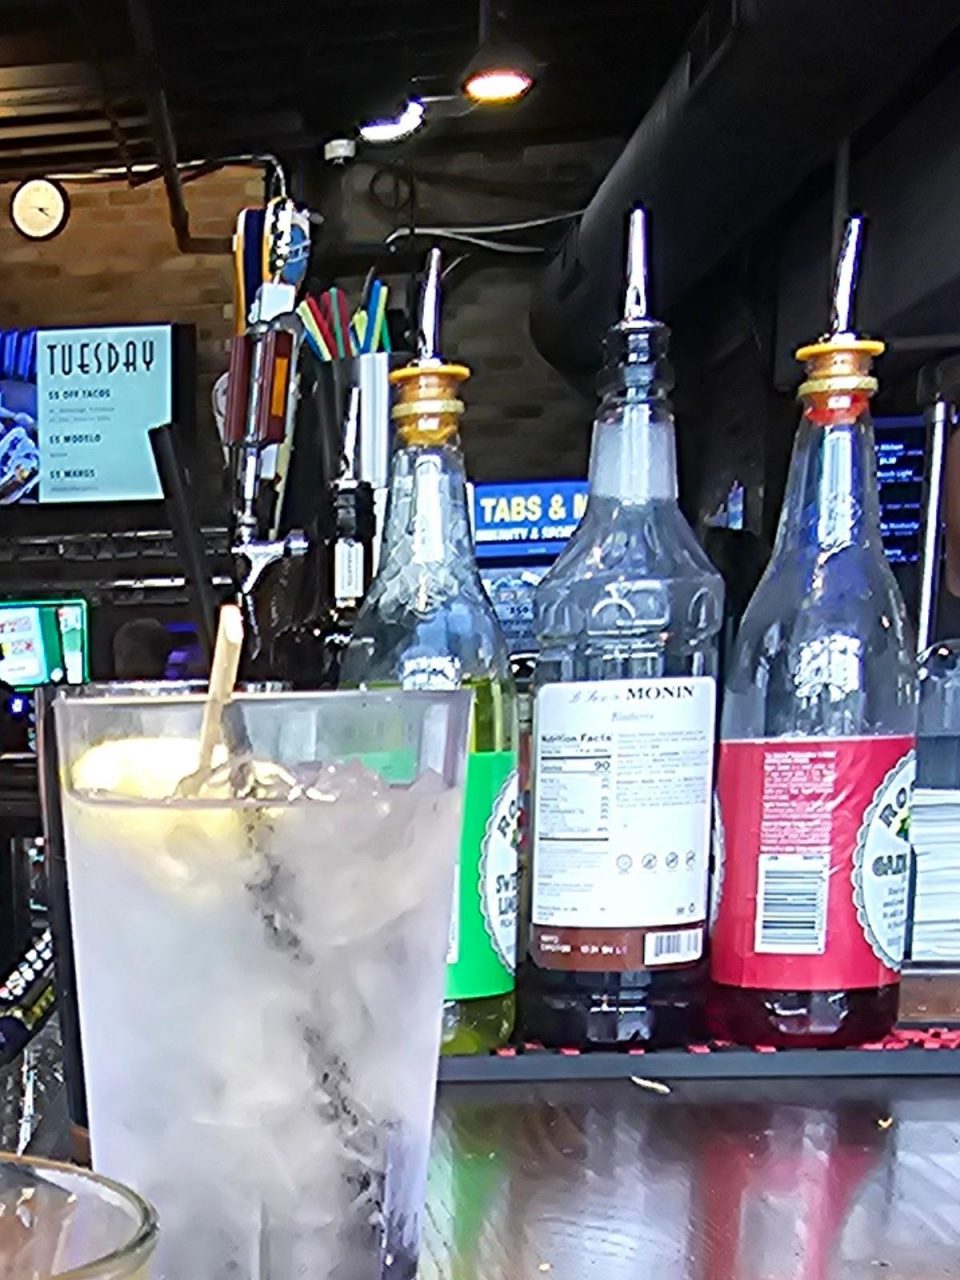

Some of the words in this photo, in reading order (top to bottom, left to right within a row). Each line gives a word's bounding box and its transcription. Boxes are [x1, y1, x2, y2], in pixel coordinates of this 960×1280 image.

[46, 340, 155, 376] TUESDAY
[63, 390, 79, 399] OFF
[82, 388, 111, 399] TACOS
[63, 433, 102, 444] MODELO
[63, 469, 95, 479] MARGS
[479, 494, 542, 524] TABS
[548, 493, 566, 521] &
[626, 685, 696, 701] MONIN
[580, 732, 612, 743] Facts
[594, 760, 611, 772] 90
